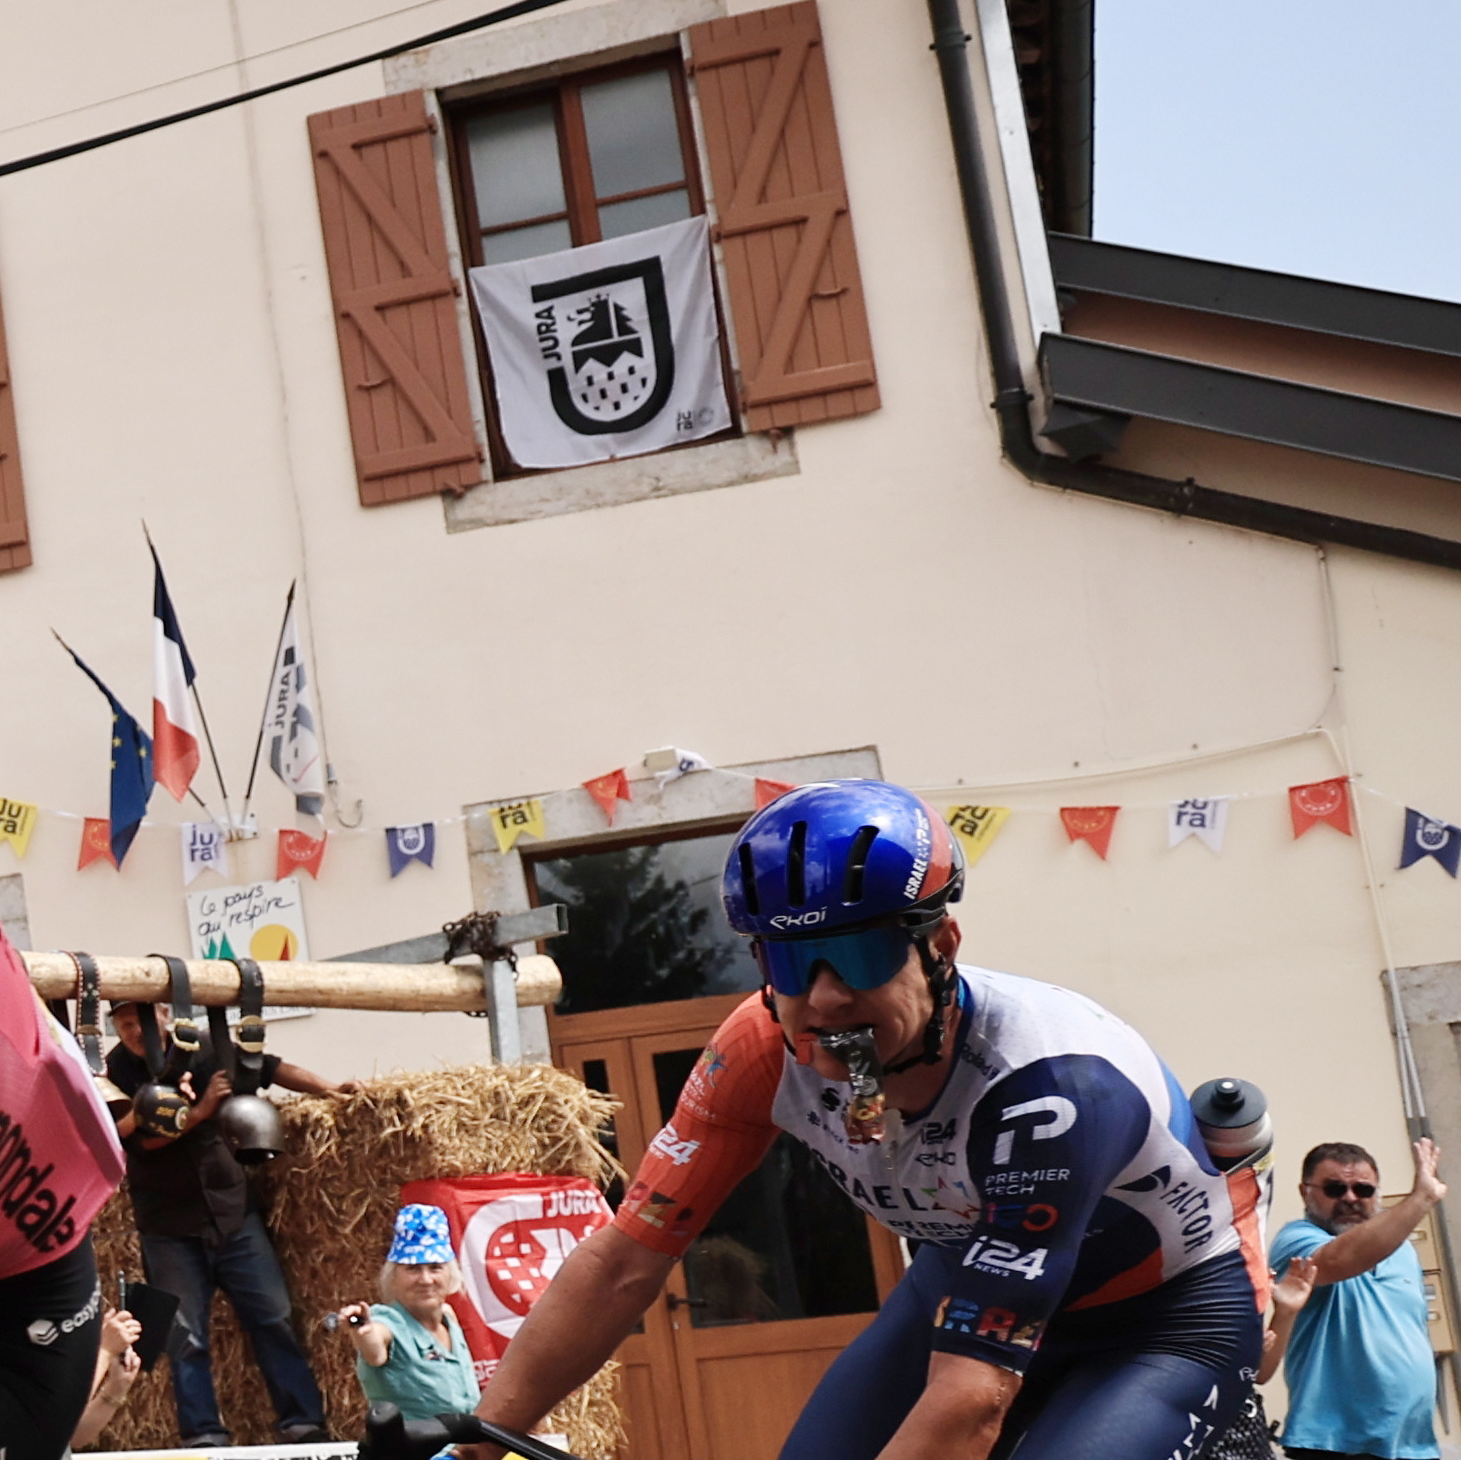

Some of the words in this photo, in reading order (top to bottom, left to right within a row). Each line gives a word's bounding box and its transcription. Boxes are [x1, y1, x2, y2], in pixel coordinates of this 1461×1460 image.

[535, 304, 563, 362] JURA
[275, 669, 292, 728] JURA
[190, 824, 215, 847] ju
[190, 847, 214, 863] ra
[903, 857, 929, 901] ISRAEL
[229, 896, 296, 930] respire
[985, 1168, 1071, 1188] PREMIER
[985, 1184, 1035, 1197] TECH
[546, 1190, 602, 1217] JURA
[1159, 1180, 1216, 1255] FACTOR
[962, 1235, 1050, 1282] i24
[973, 1263, 1011, 1279] NEWS
